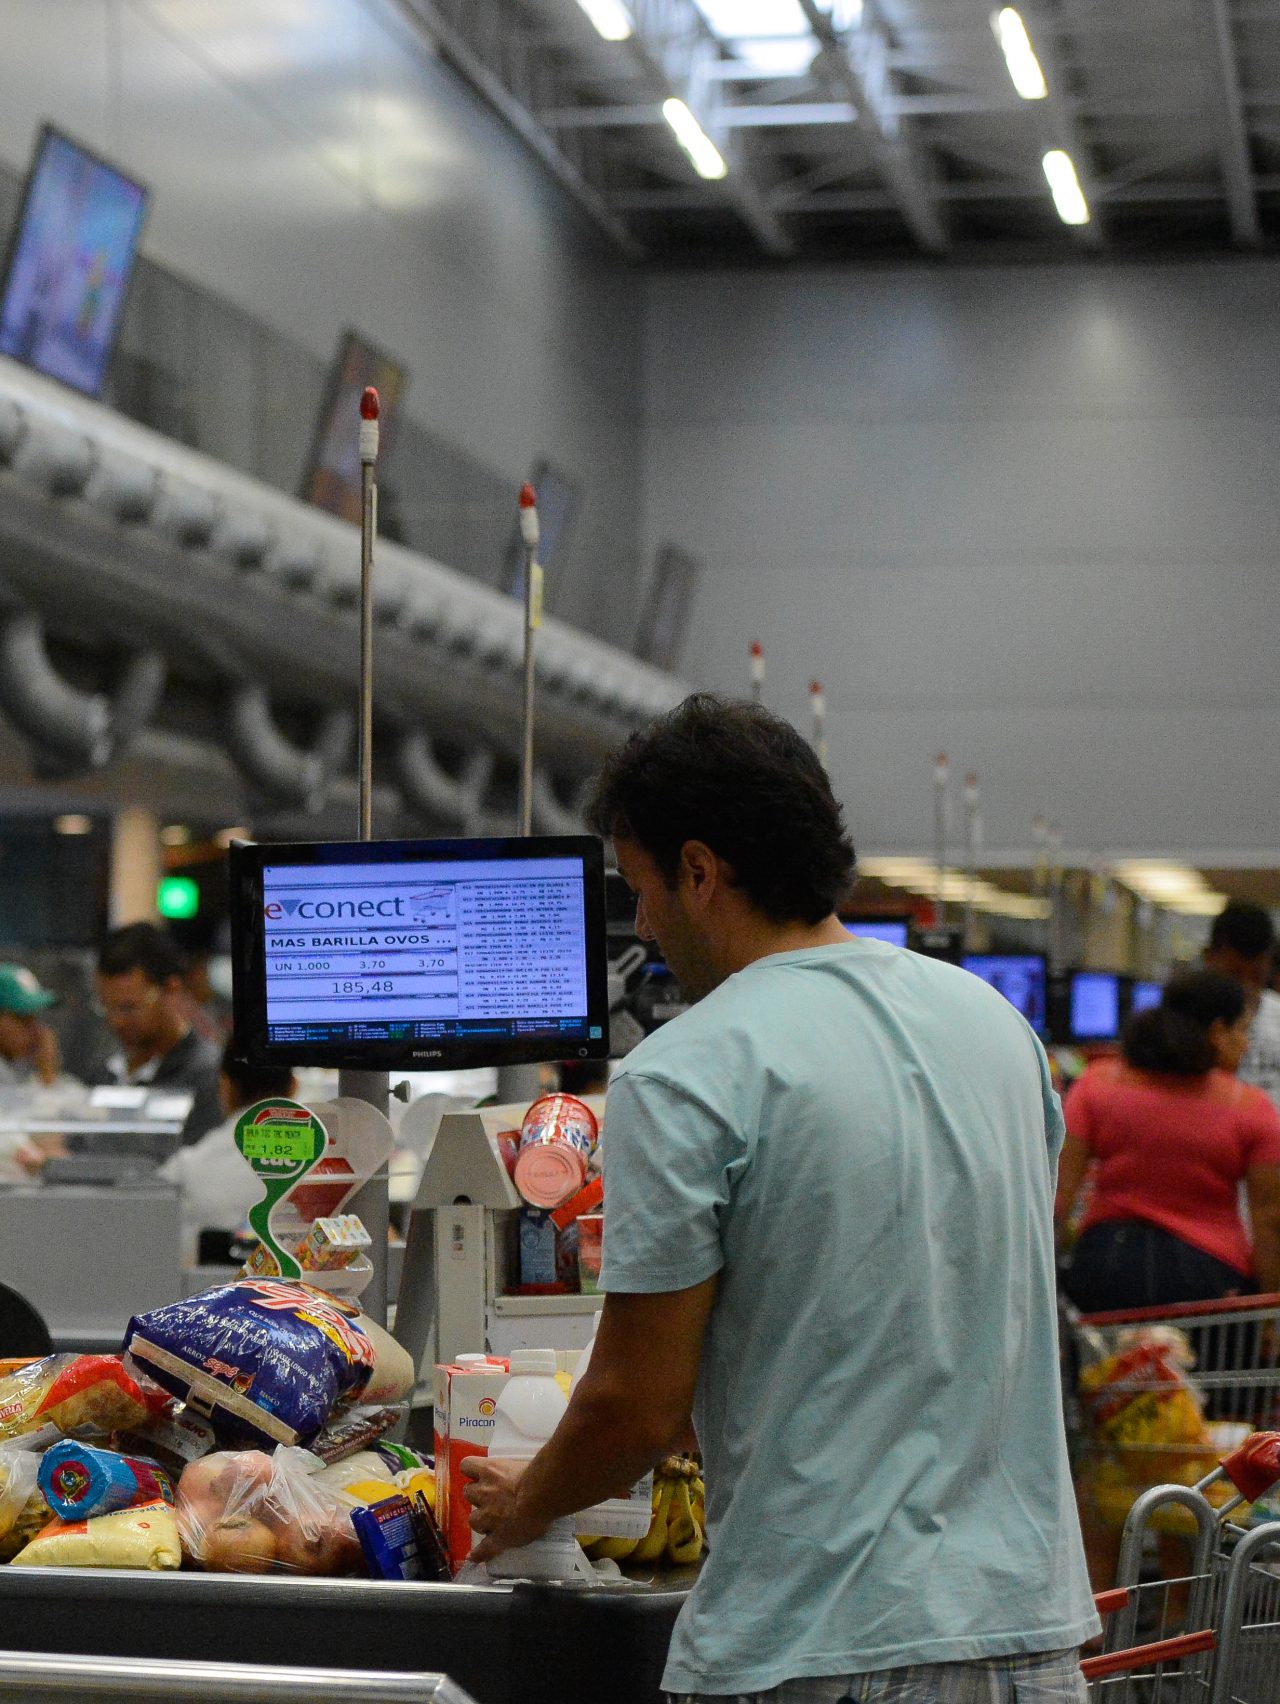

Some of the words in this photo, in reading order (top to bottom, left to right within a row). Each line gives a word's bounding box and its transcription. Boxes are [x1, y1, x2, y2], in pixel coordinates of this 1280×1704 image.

[271, 938, 306, 948] MAS
[311, 936, 379, 947] BARILLA
[384, 935, 430, 945] OVOS
[275, 963, 293, 971] UN
[332, 980, 394, 994] 185,48
[412, 1050, 442, 1059] PHILIPS
[181, 1345, 207, 1361] ARROZ
